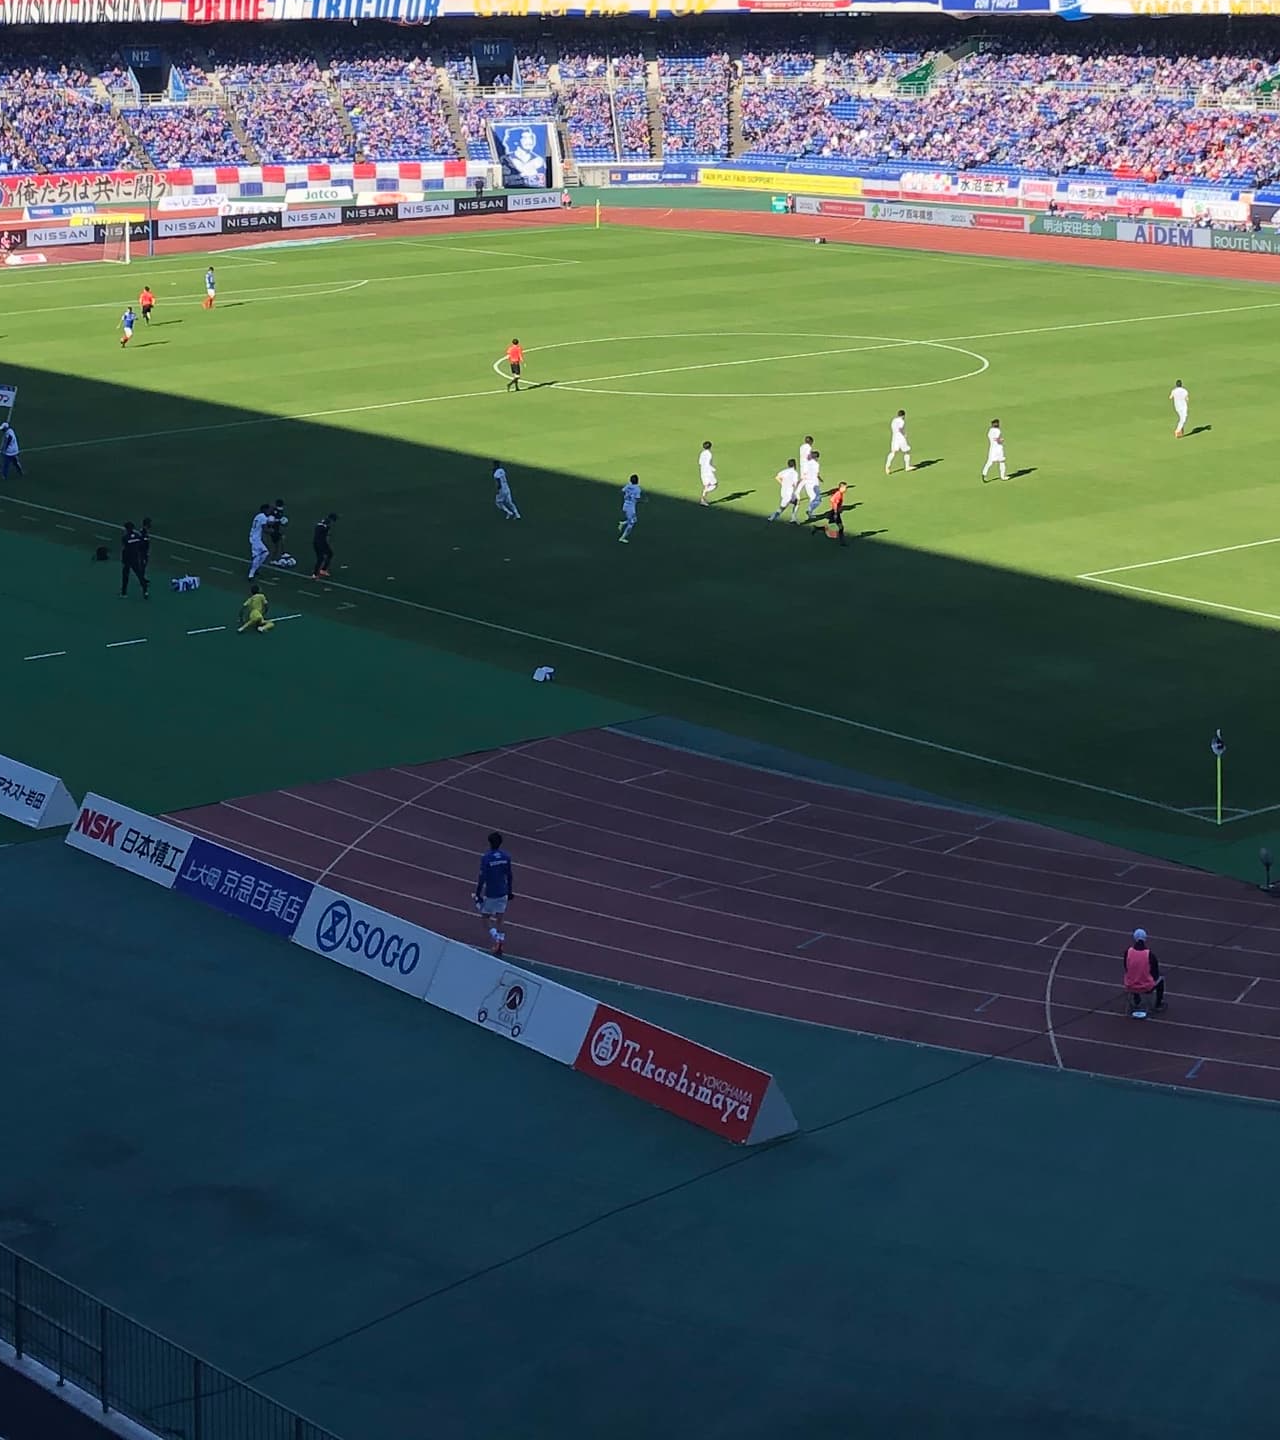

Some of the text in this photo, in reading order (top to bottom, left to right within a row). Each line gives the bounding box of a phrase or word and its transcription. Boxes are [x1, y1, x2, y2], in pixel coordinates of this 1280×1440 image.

[131, 50, 150, 62] N12
[483, 43, 500, 56] N11
[17, 173, 168, 205] 俺たちは共に闘う
[458, 199, 504, 210] NISSAN
[513, 196, 556, 206] NISSAN
[346, 207, 394, 219] NISSAN
[403, 203, 449, 214] NISSAN
[226, 215, 277, 228] NISSAN
[287, 211, 336, 223] NISSAN
[164, 220, 216, 232] NISSAN
[1043, 218, 1102, 237] 明治安田生命
[33, 229, 88, 241] NISSAN
[1214, 236, 1249, 250] ROUTE
[74, 808, 185, 873] NSK 日本精工
[181, 860, 304, 925] 上大岡 京急百貨店
[346, 919, 420, 976] SOGO
[620, 1039, 750, 1123] Takashimaya
[702, 1073, 753, 1106] YOKOHAMA
